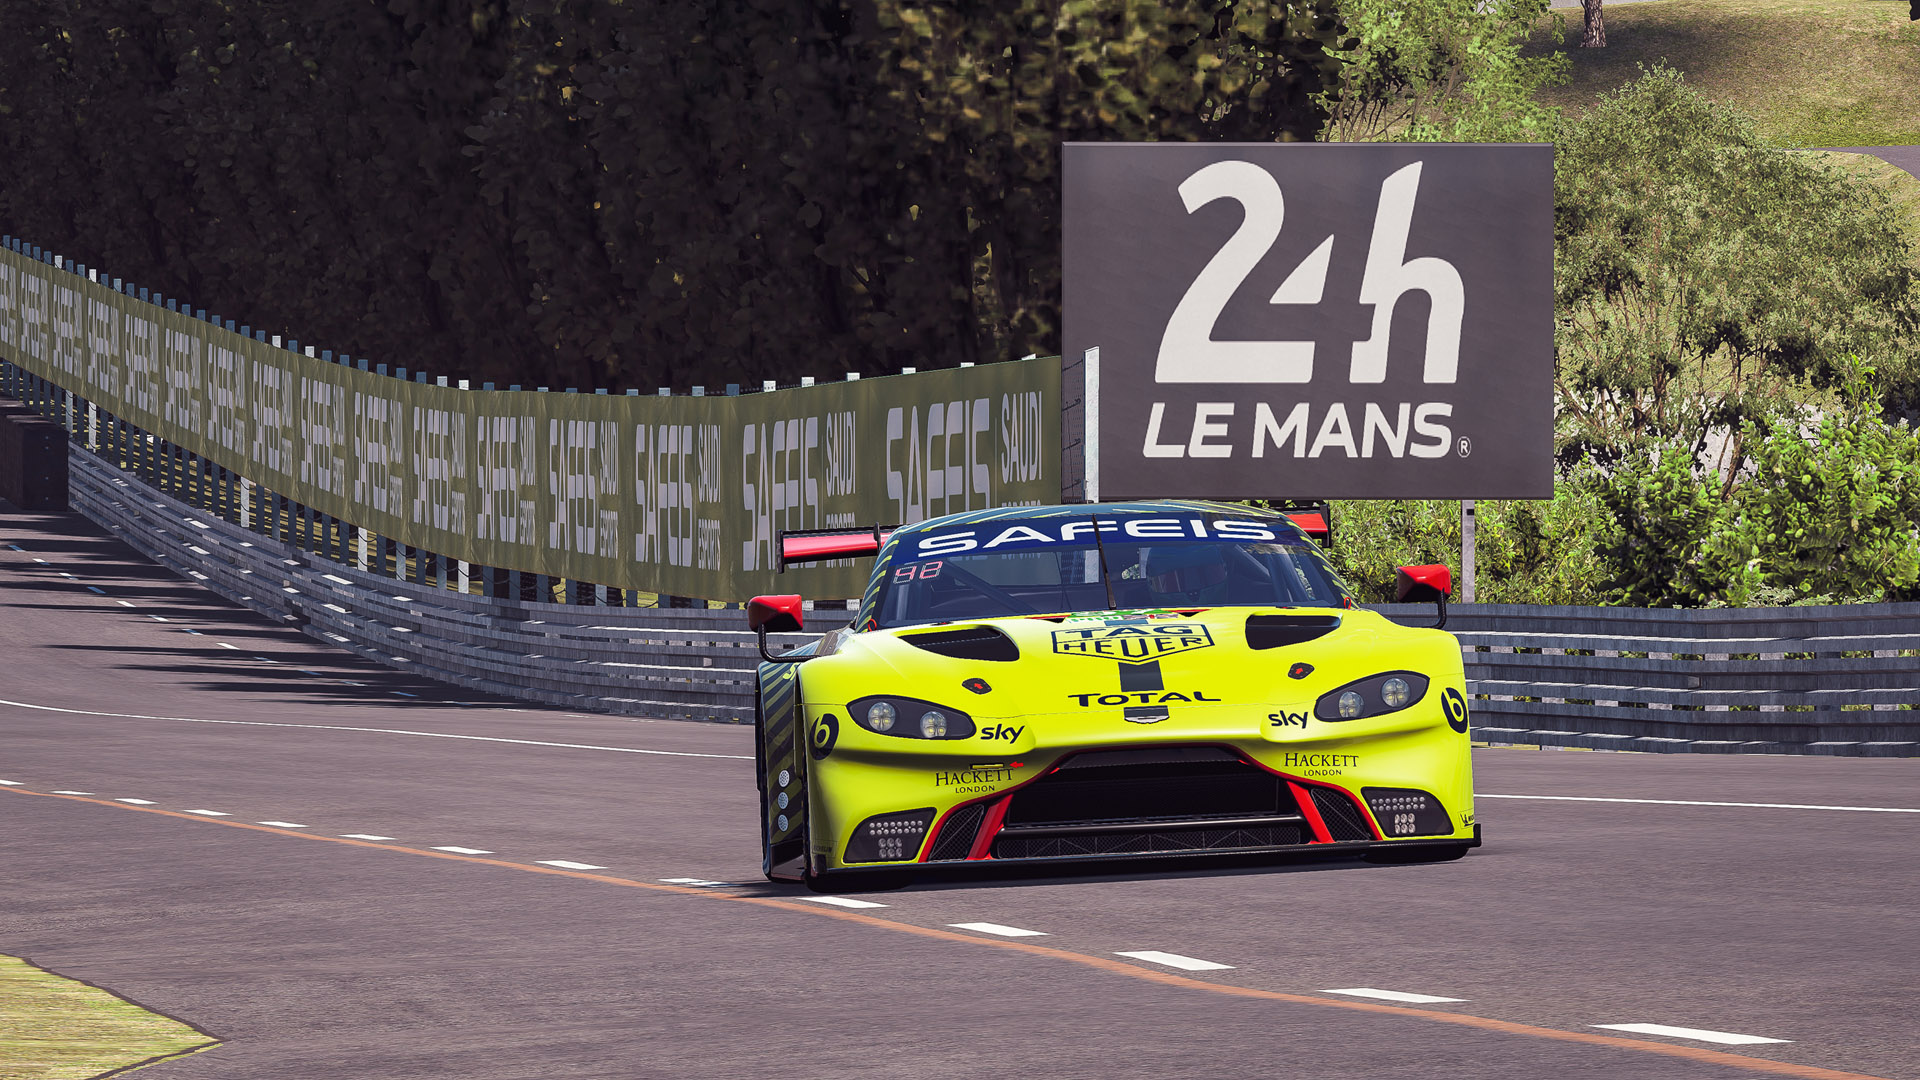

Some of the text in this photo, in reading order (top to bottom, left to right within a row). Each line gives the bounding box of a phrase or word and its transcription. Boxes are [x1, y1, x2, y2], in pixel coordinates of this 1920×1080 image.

[1155, 160, 1465, 383] 24h
[302, 377, 331, 493] SAFEIS
[355, 392, 387, 512] SAFEIS
[520, 415, 535, 486] SAUDI
[600, 420, 618, 495] SAUDI
[698, 423, 720, 503] SAUDI
[826, 411, 856, 498] SAUDI
[1001, 391, 1042, 485] SAUDI
[1143, 402, 1235, 458] LE
[1251, 402, 1453, 458] MANS
[414, 407, 448, 531] SAFEIS
[478, 416, 516, 543] SAFEIS
[550, 418, 595, 555] SAFEIS
[636, 424, 692, 568] SAFEIS
[743, 417, 818, 571] SAFEIS
[698, 518, 720, 571] ESPORTS
[918, 519, 1276, 557] SAFEIS
[1064, 637, 1202, 657] HEUER
[1065, 625, 1193, 638] TAG
[980, 724, 1025, 744] sky
[1068, 691, 1221, 707] TOTAL
[1268, 710, 1308, 729] sky
[936, 768, 1014, 786] HACKETT
[955, 785, 995, 793] LONDON
[1284, 753, 1359, 767] HACKETT
